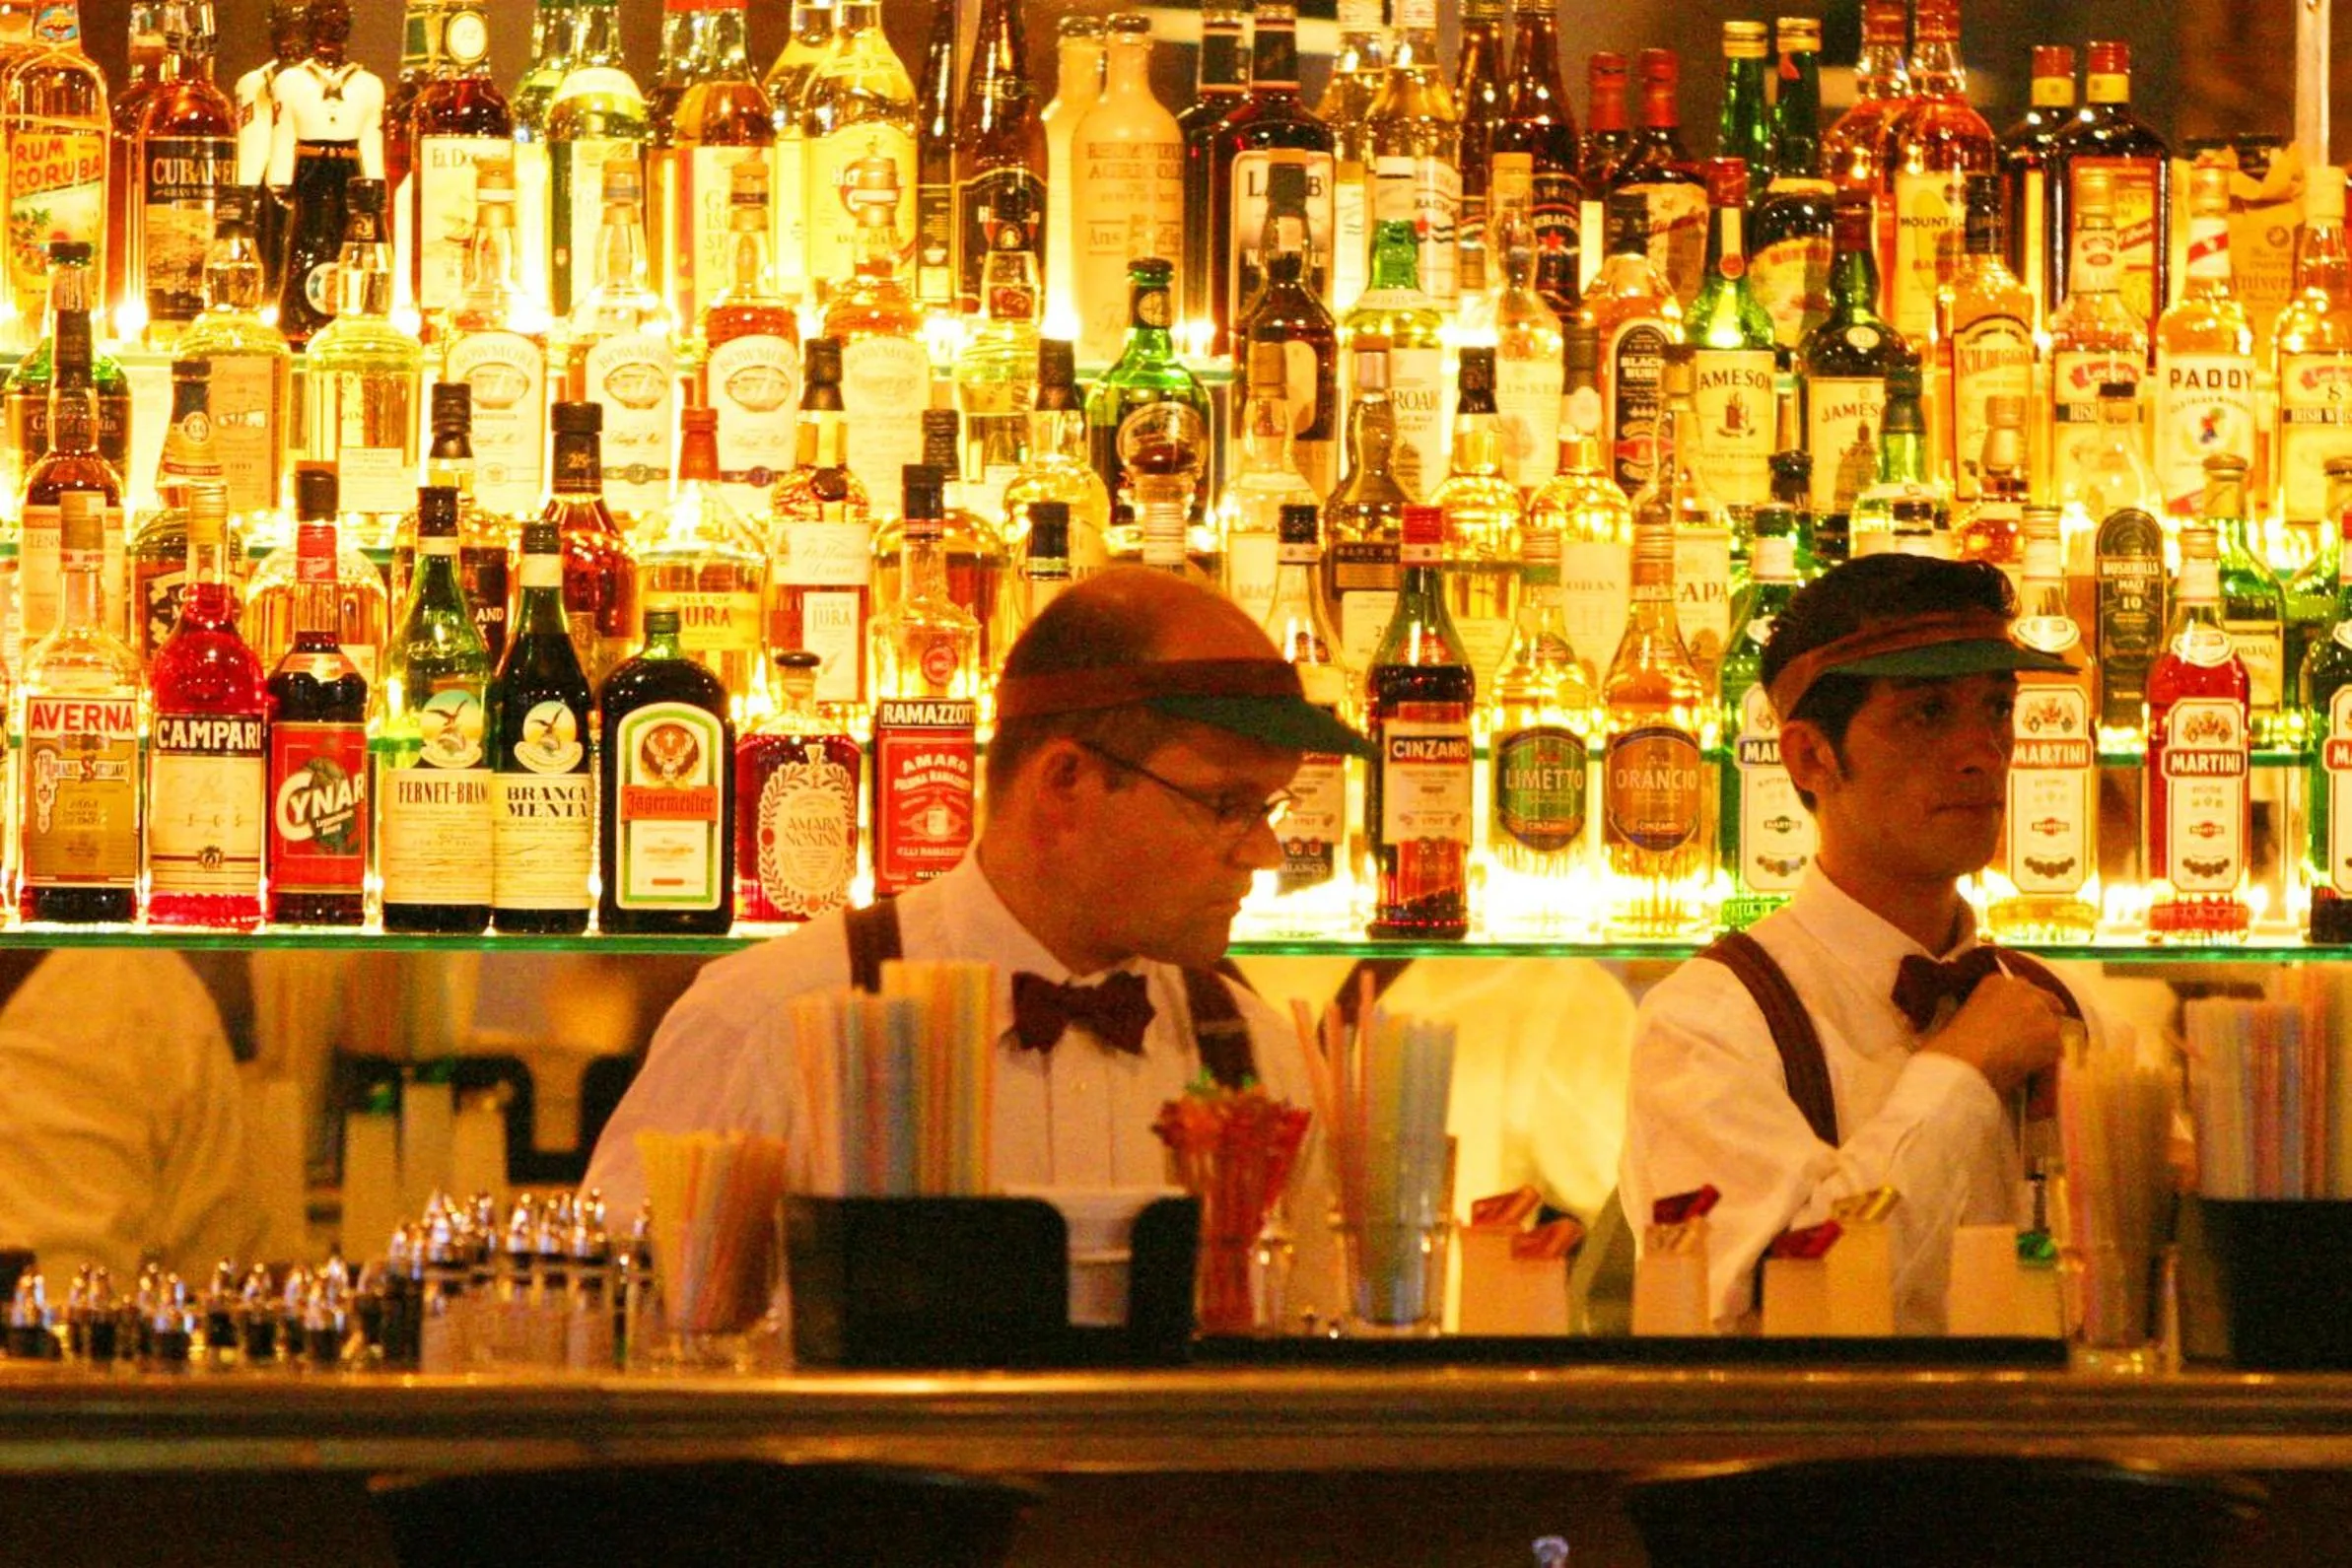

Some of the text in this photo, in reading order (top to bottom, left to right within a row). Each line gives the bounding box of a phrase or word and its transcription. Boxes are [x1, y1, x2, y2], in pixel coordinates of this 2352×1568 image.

[15, 138, 66, 165] RUM
[14, 155, 103, 190] CORUBA
[152, 158, 239, 186] CUBANE
[1900, 217, 1949, 229] MOUNT
[2170, 368, 2254, 391] PADDY
[1821, 402, 1880, 424] JAMES
[2122, 595, 2142, 610] 10
[683, 605, 732, 629] URA
[812, 608, 853, 633] JURA
[31, 703, 135, 731] AVERNA
[157, 719, 262, 750] CAMPARI
[1391, 739, 1469, 760] CINZANO
[2012, 743, 2088, 766] MARTINI
[902, 754, 968, 776] AMARO
[2171, 753, 2242, 774] MARTINI
[1504, 768, 1585, 790] LIMETTO
[398, 782, 491, 805] FERNET-BRAN
[507, 785, 588, 801] BRANCA
[276, 772, 366, 842] CYNAR
[507, 803, 588, 819] MENTA
